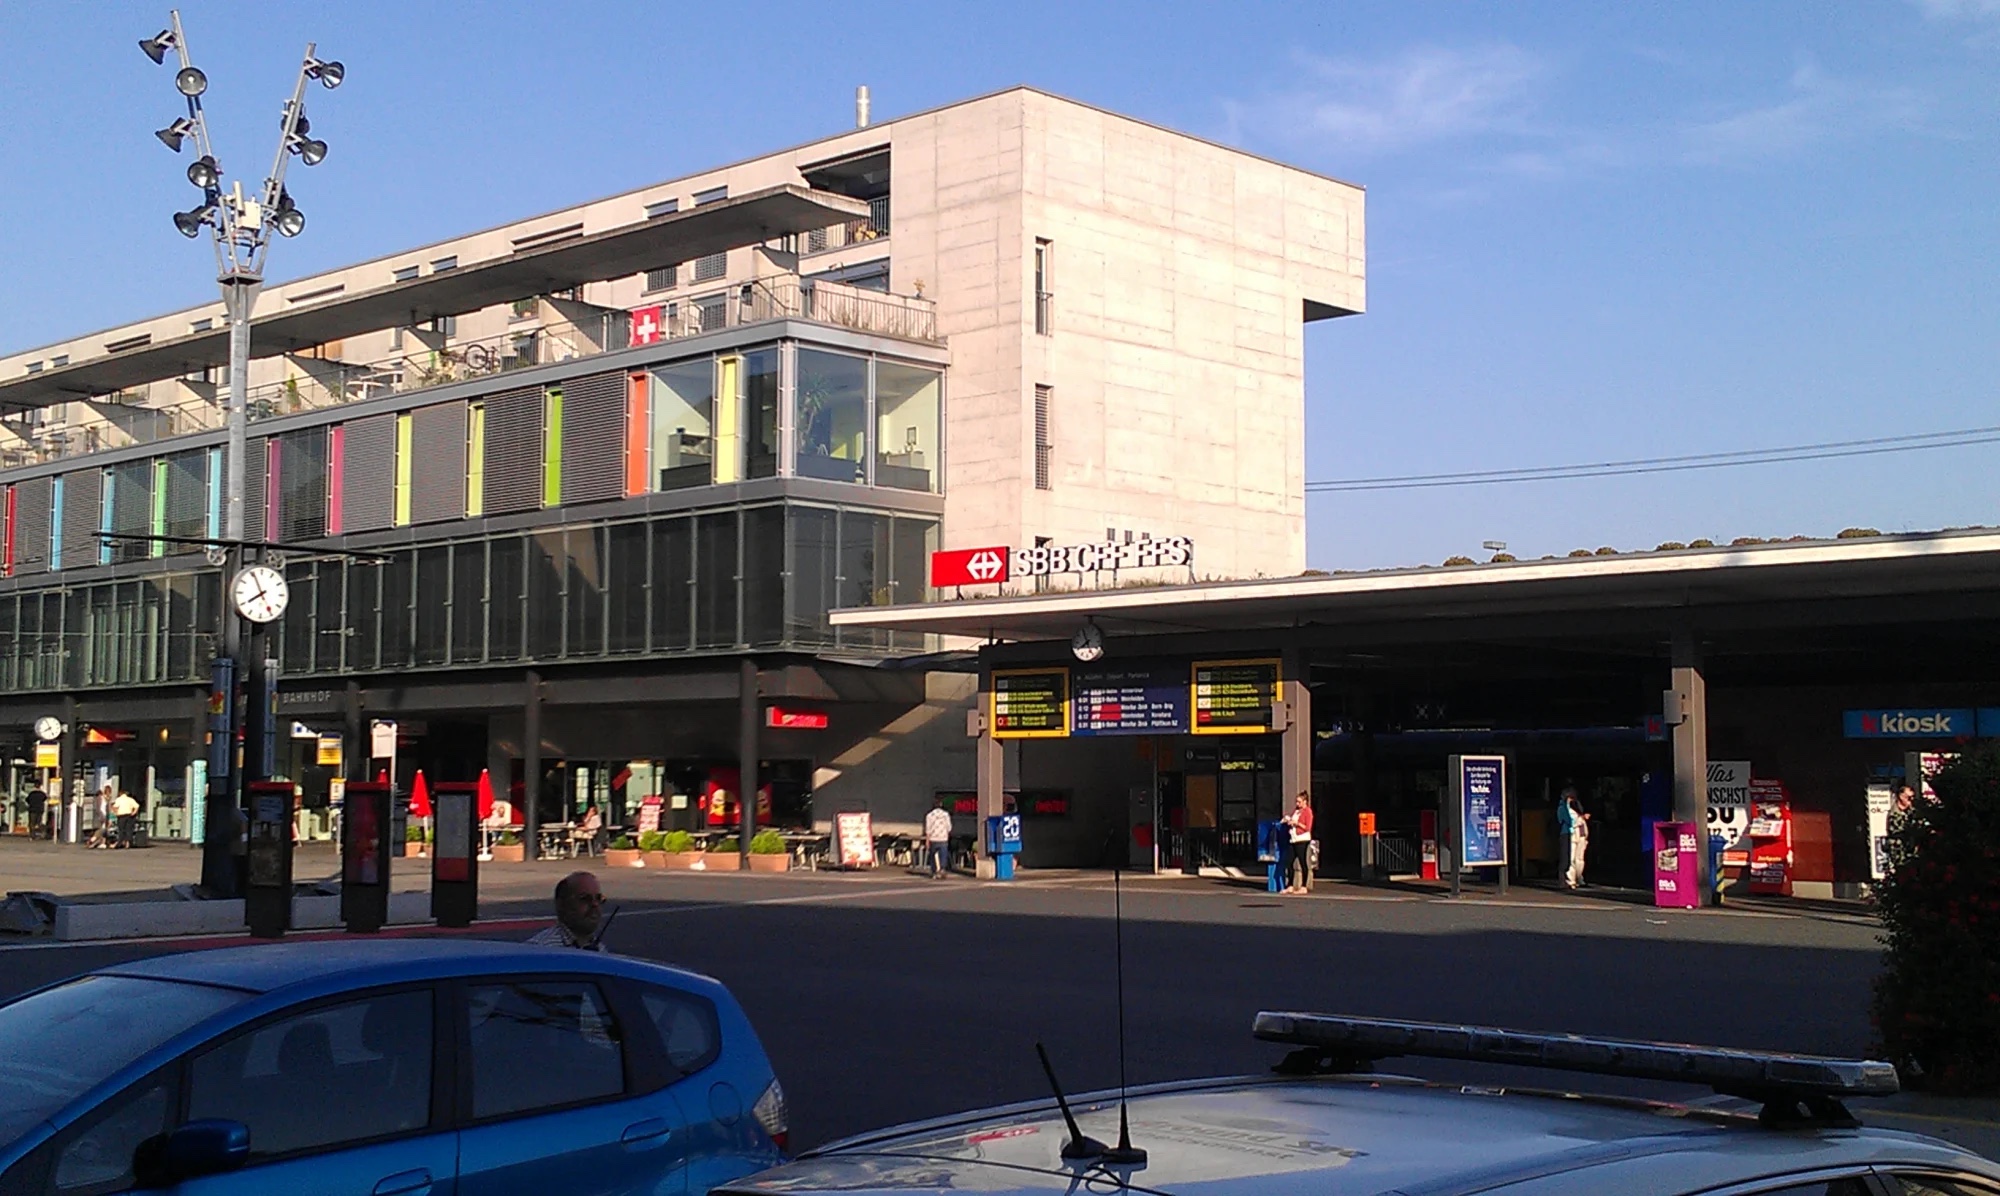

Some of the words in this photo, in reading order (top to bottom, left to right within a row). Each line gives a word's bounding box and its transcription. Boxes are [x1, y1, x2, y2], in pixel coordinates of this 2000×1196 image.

[1015, 546, 1067, 576] SBB
[1076, 541, 1126, 572] CFF
[1134, 536, 1189, 567] FFS
[283, 690, 331, 704] BAHNHOF
[1881, 712, 1952, 733] kiosk
[1706, 787, 1748, 804] NSCHST
